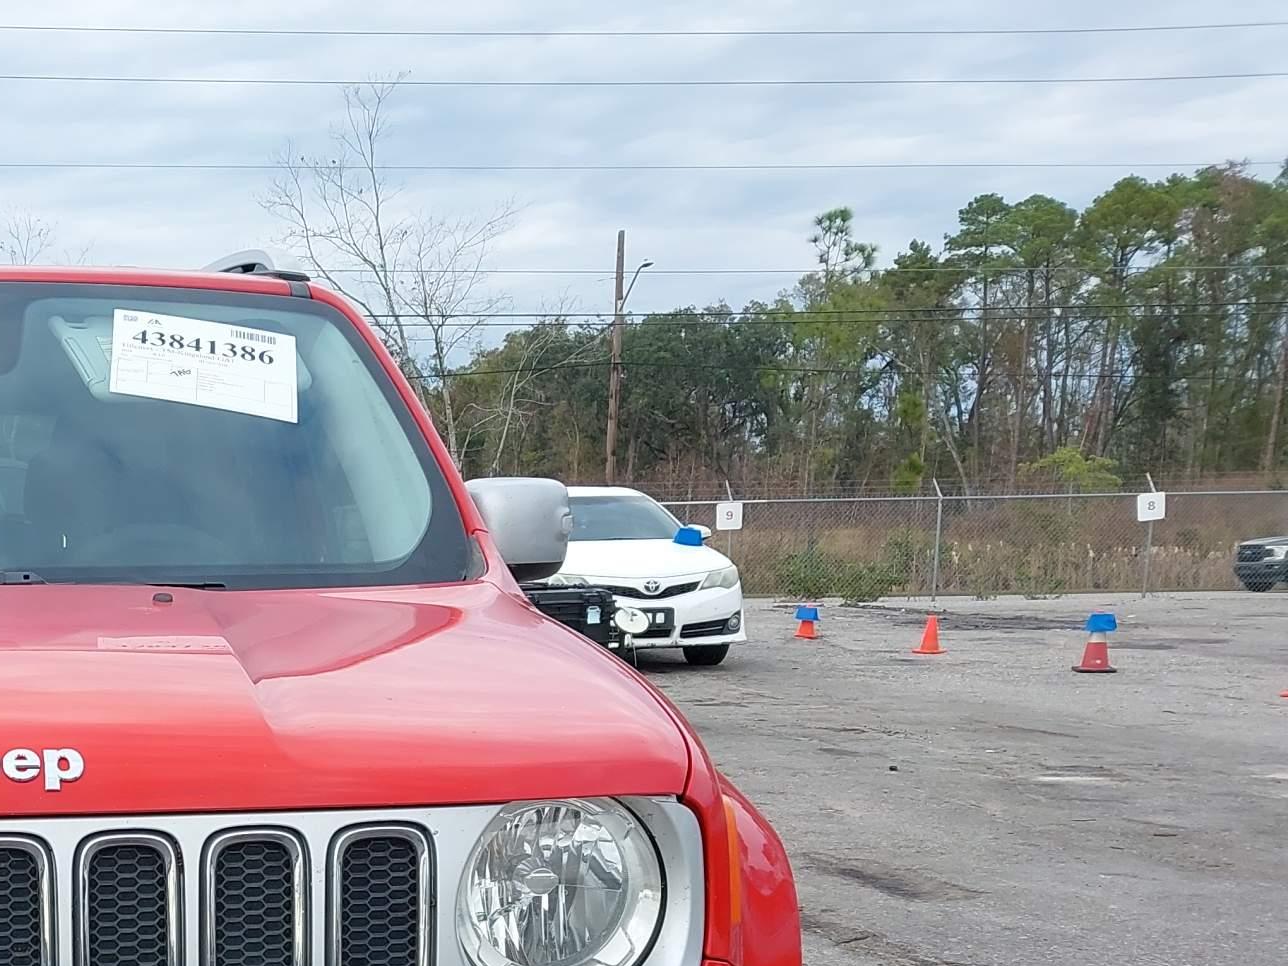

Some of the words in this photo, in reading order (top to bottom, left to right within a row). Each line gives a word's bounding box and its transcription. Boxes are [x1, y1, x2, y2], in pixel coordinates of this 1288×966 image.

[132, 329, 275, 365] 43841386
[1147, 500, 1156, 511] 8
[726, 510, 734, 521] 9
